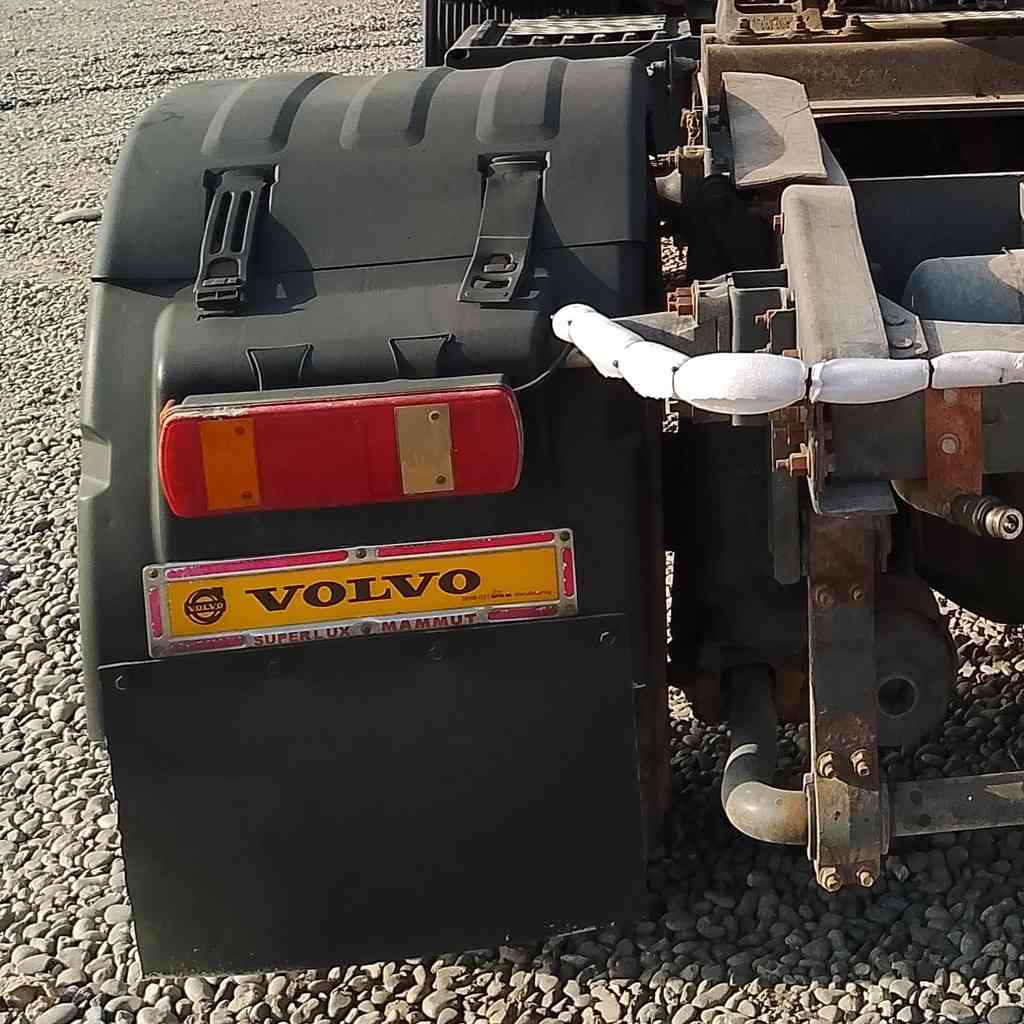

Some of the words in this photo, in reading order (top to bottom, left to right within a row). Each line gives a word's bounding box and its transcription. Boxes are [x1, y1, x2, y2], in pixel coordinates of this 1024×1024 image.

[244, 568, 482, 613] VOLVO
[253, 628, 309, 646] SUPER
[314, 625, 351, 641] LUX
[381, 613, 479, 633] MAMMUT
